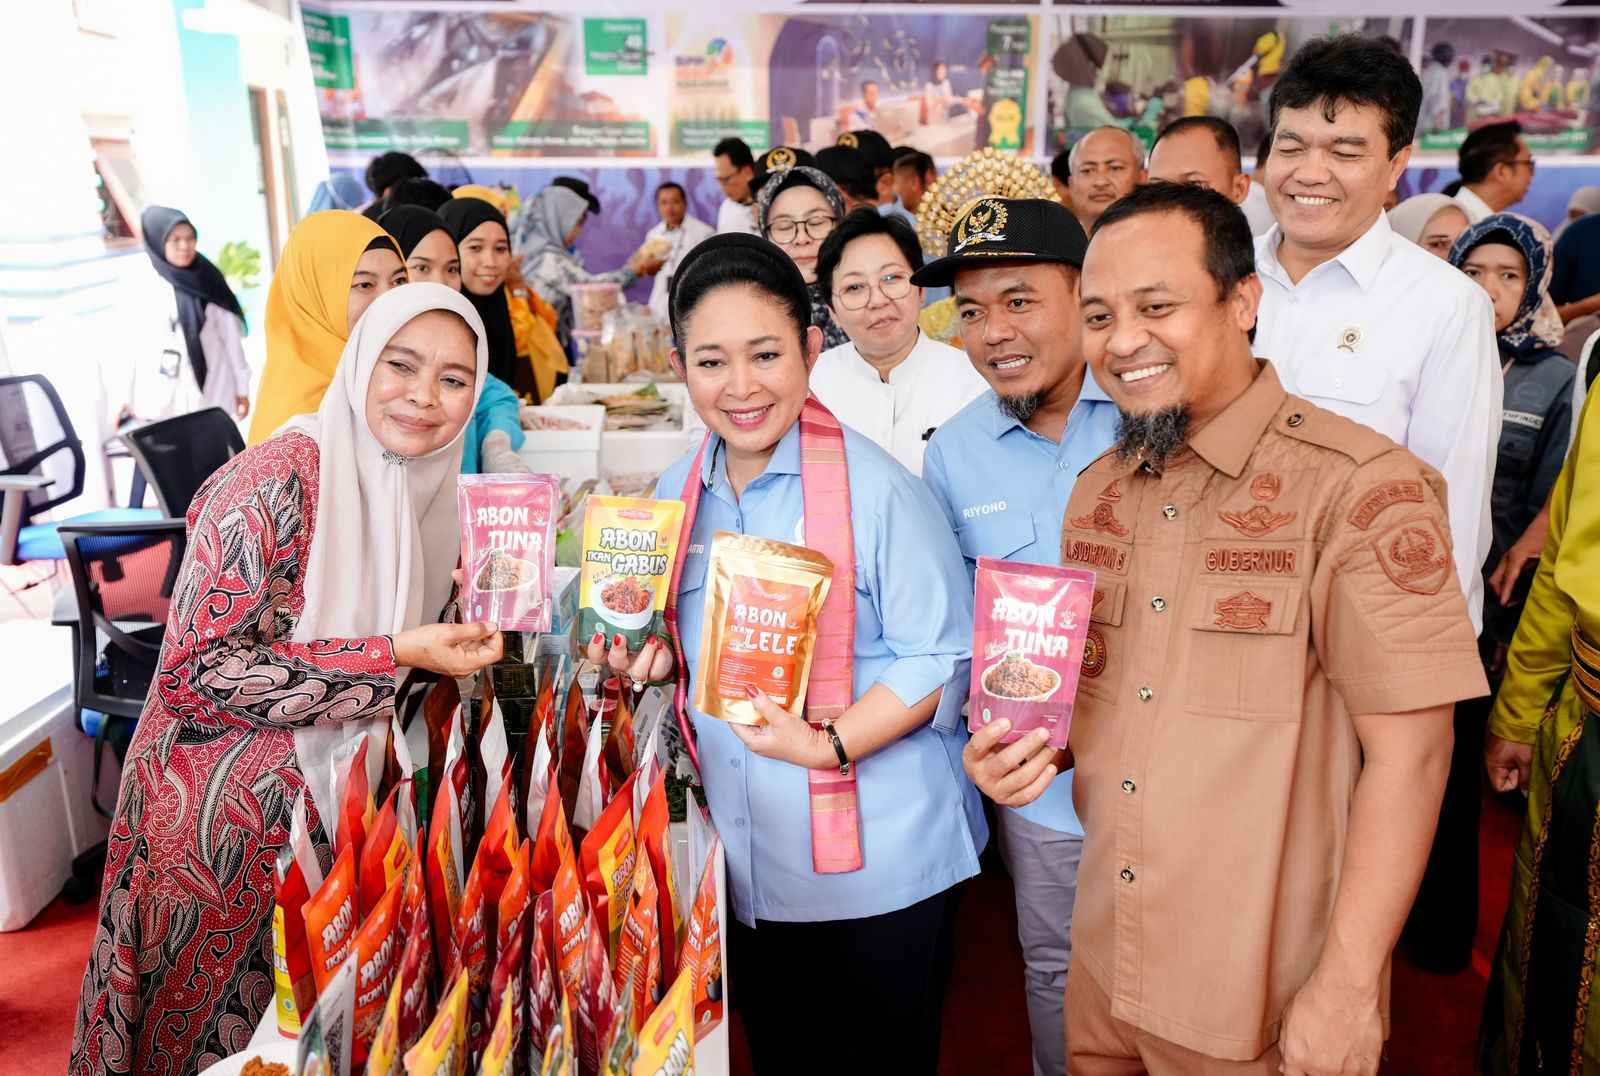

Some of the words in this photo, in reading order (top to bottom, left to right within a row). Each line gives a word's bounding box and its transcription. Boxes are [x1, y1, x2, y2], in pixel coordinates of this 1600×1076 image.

[477, 506, 529, 528] ABON
[962, 500, 1007, 519] RIYONO
[488, 531, 542, 551] TUNA
[599, 528, 658, 552] ABON
[586, 551, 612, 564] IKAN
[610, 553, 669, 576] GABUS
[1206, 547, 1301, 573] GUBERNUR
[734, 604, 788, 629] ABON
[992, 597, 1056, 629] ABON
[744, 628, 800, 656] LELE
[1004, 628, 1068, 658] TUNA
[360, 929, 394, 990] ABON
